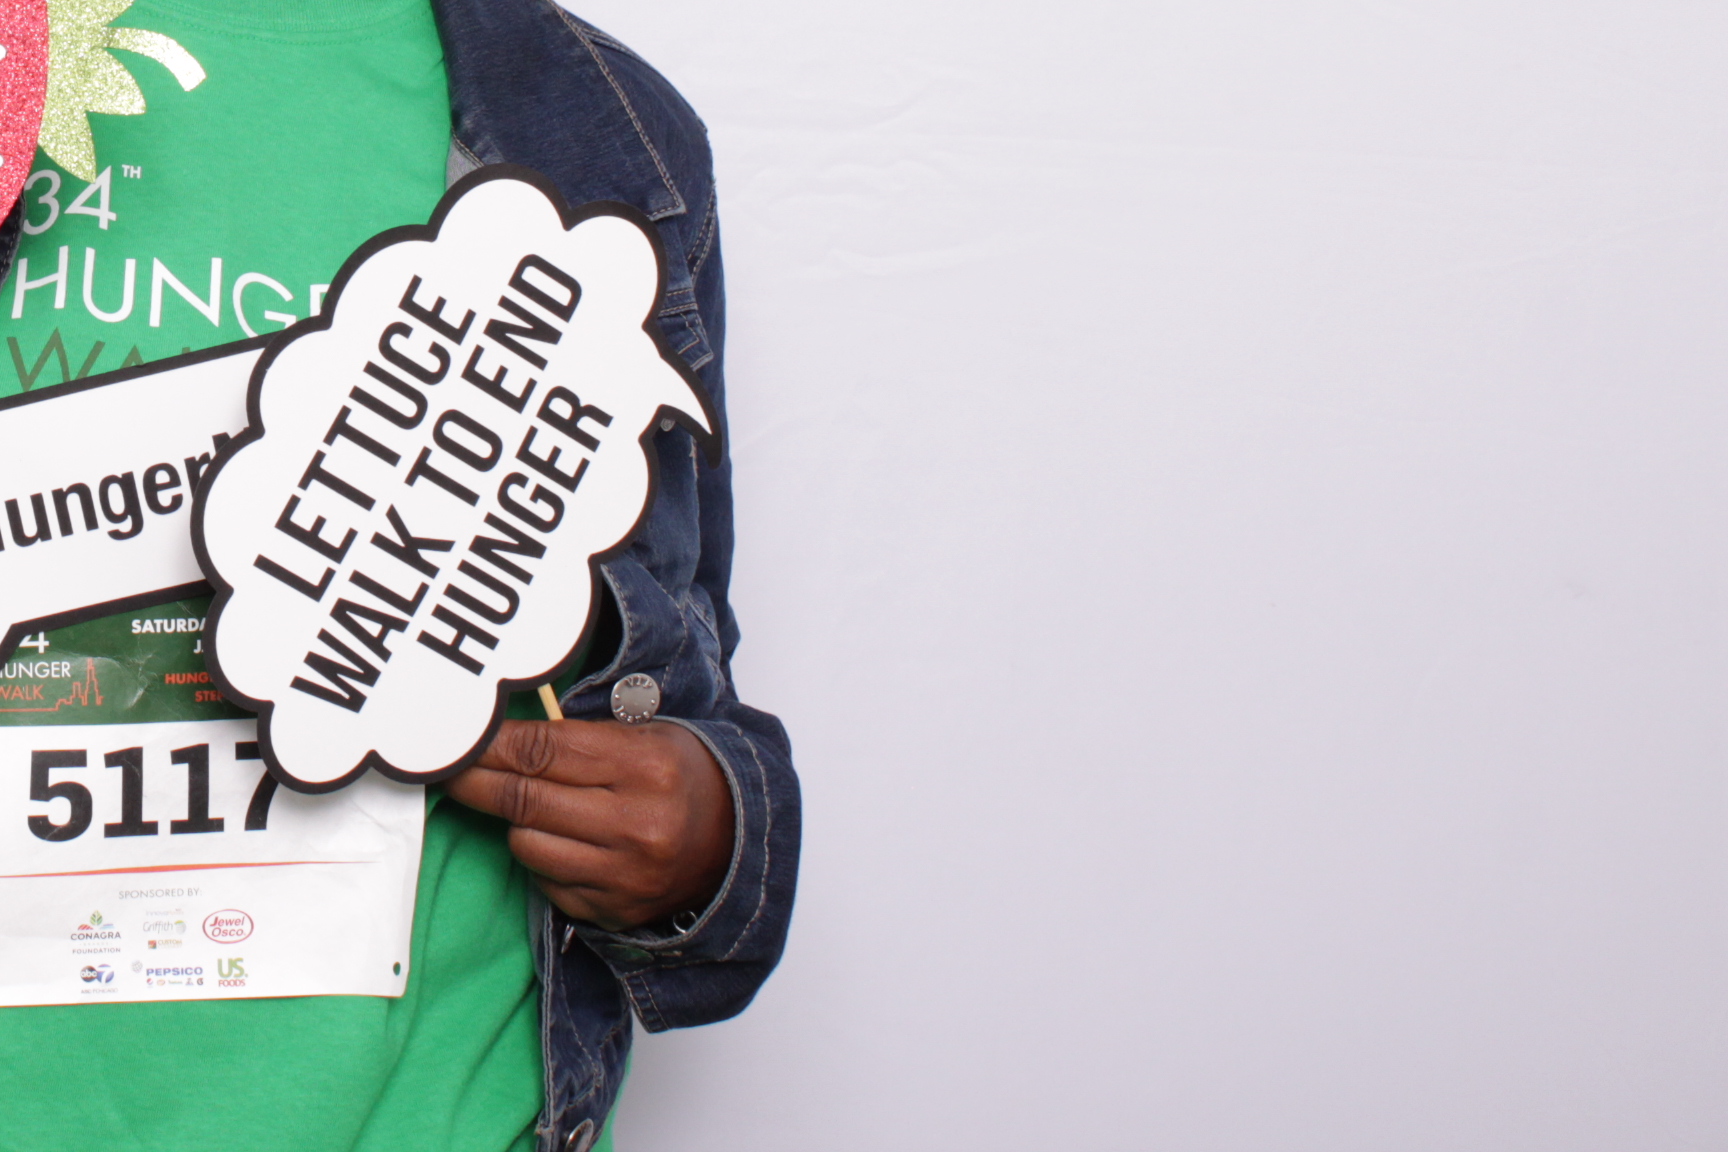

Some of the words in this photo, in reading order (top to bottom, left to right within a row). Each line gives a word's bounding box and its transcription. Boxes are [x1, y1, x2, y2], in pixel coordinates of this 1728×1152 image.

[254, 275, 476, 602] LETTUCE
[290, 504, 455, 714] WALK
[404, 409, 503, 507] TO
[461, 254, 582, 414] END
[416, 386, 613, 676] HUNGER
[165, 671, 214, 685] HUNG
[27, 742, 279, 842] 5117
[118, 887, 184, 900] SPONSORED
[209, 915, 246, 927] Jewel
[142, 921, 174, 935] Griffith
[70, 931, 122, 941] CONAGRA
[72, 947, 121, 955] FOUNDATION
[145, 966, 204, 977] PEPSICO
[218, 979, 246, 988] FOODS
